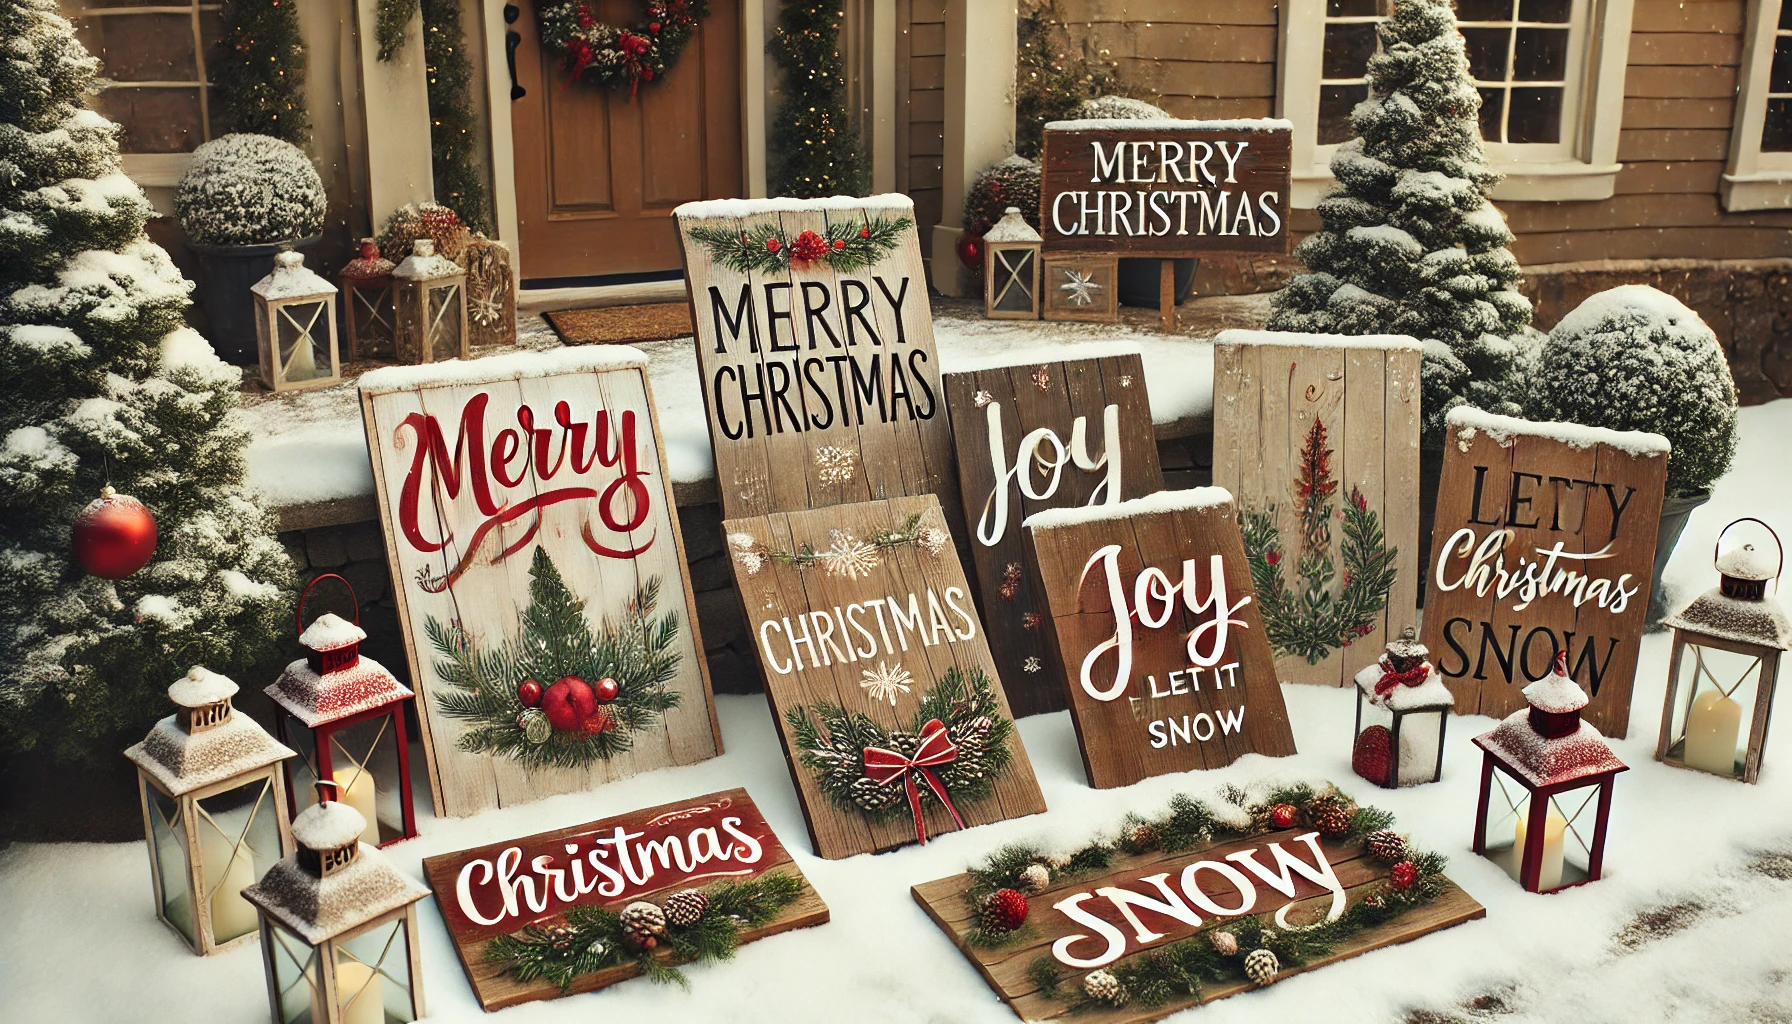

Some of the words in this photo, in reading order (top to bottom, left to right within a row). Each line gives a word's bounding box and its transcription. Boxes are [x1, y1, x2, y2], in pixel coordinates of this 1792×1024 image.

[1090, 140, 1249, 185] MERRY
[1052, 190, 1281, 237] CHRISTMAS
[708, 276, 909, 354] MERRY
[713, 348, 936, 441] CHRISTMAS
[394, 392, 654, 559] Merry
[977, 402, 1121, 547] Joy
[1436, 528, 1642, 613] Christmas
[760, 587, 976, 674] CHRISTMAS
[1079, 544, 1252, 702] Joy
[1438, 617, 1620, 697] SNOW
[1148, 667, 1204, 698] LET
[1214, 662, 1240, 690] IT
[1148, 705, 1245, 749] SNOW
[456, 816, 763, 925] Christmas
[1051, 831, 1348, 969] SNOW
